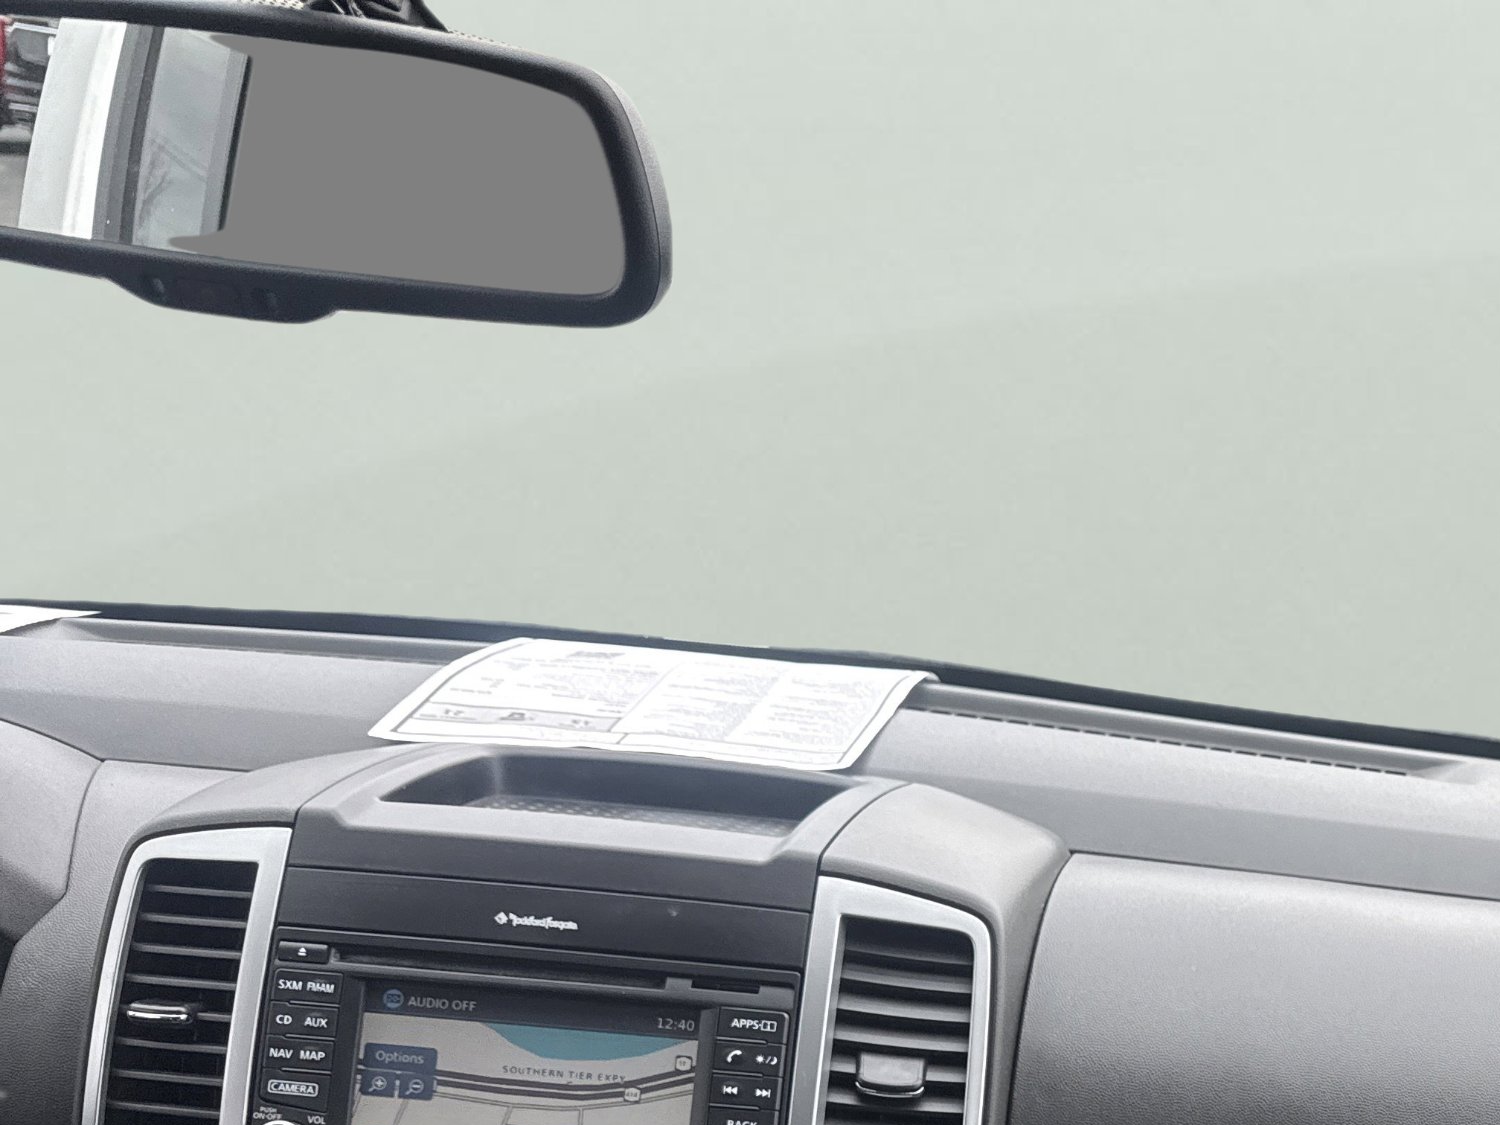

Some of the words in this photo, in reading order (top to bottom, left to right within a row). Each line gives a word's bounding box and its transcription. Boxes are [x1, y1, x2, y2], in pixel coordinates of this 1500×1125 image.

[278, 979, 302, 991] SXM
[408, 996, 449, 1010] AUDIO
[452, 1000, 477, 1012] OFF
[276, 1014, 292, 1025] CD
[304, 1016, 328, 1028] AUX
[657, 1017, 695, 1032] 12:40
[268, 1047, 293, 1059] NAV
[300, 1050, 326, 1061] MAP
[375, 1050, 425, 1064] Options
[502, 1065, 564, 1078] SOUTHERN
[568, 1070, 593, 1080] TIER
[599, 1073, 626, 1084] EXPY
[270, 1082, 314, 1095] CAMERA
[307, 1115, 326, 1125] VOL
